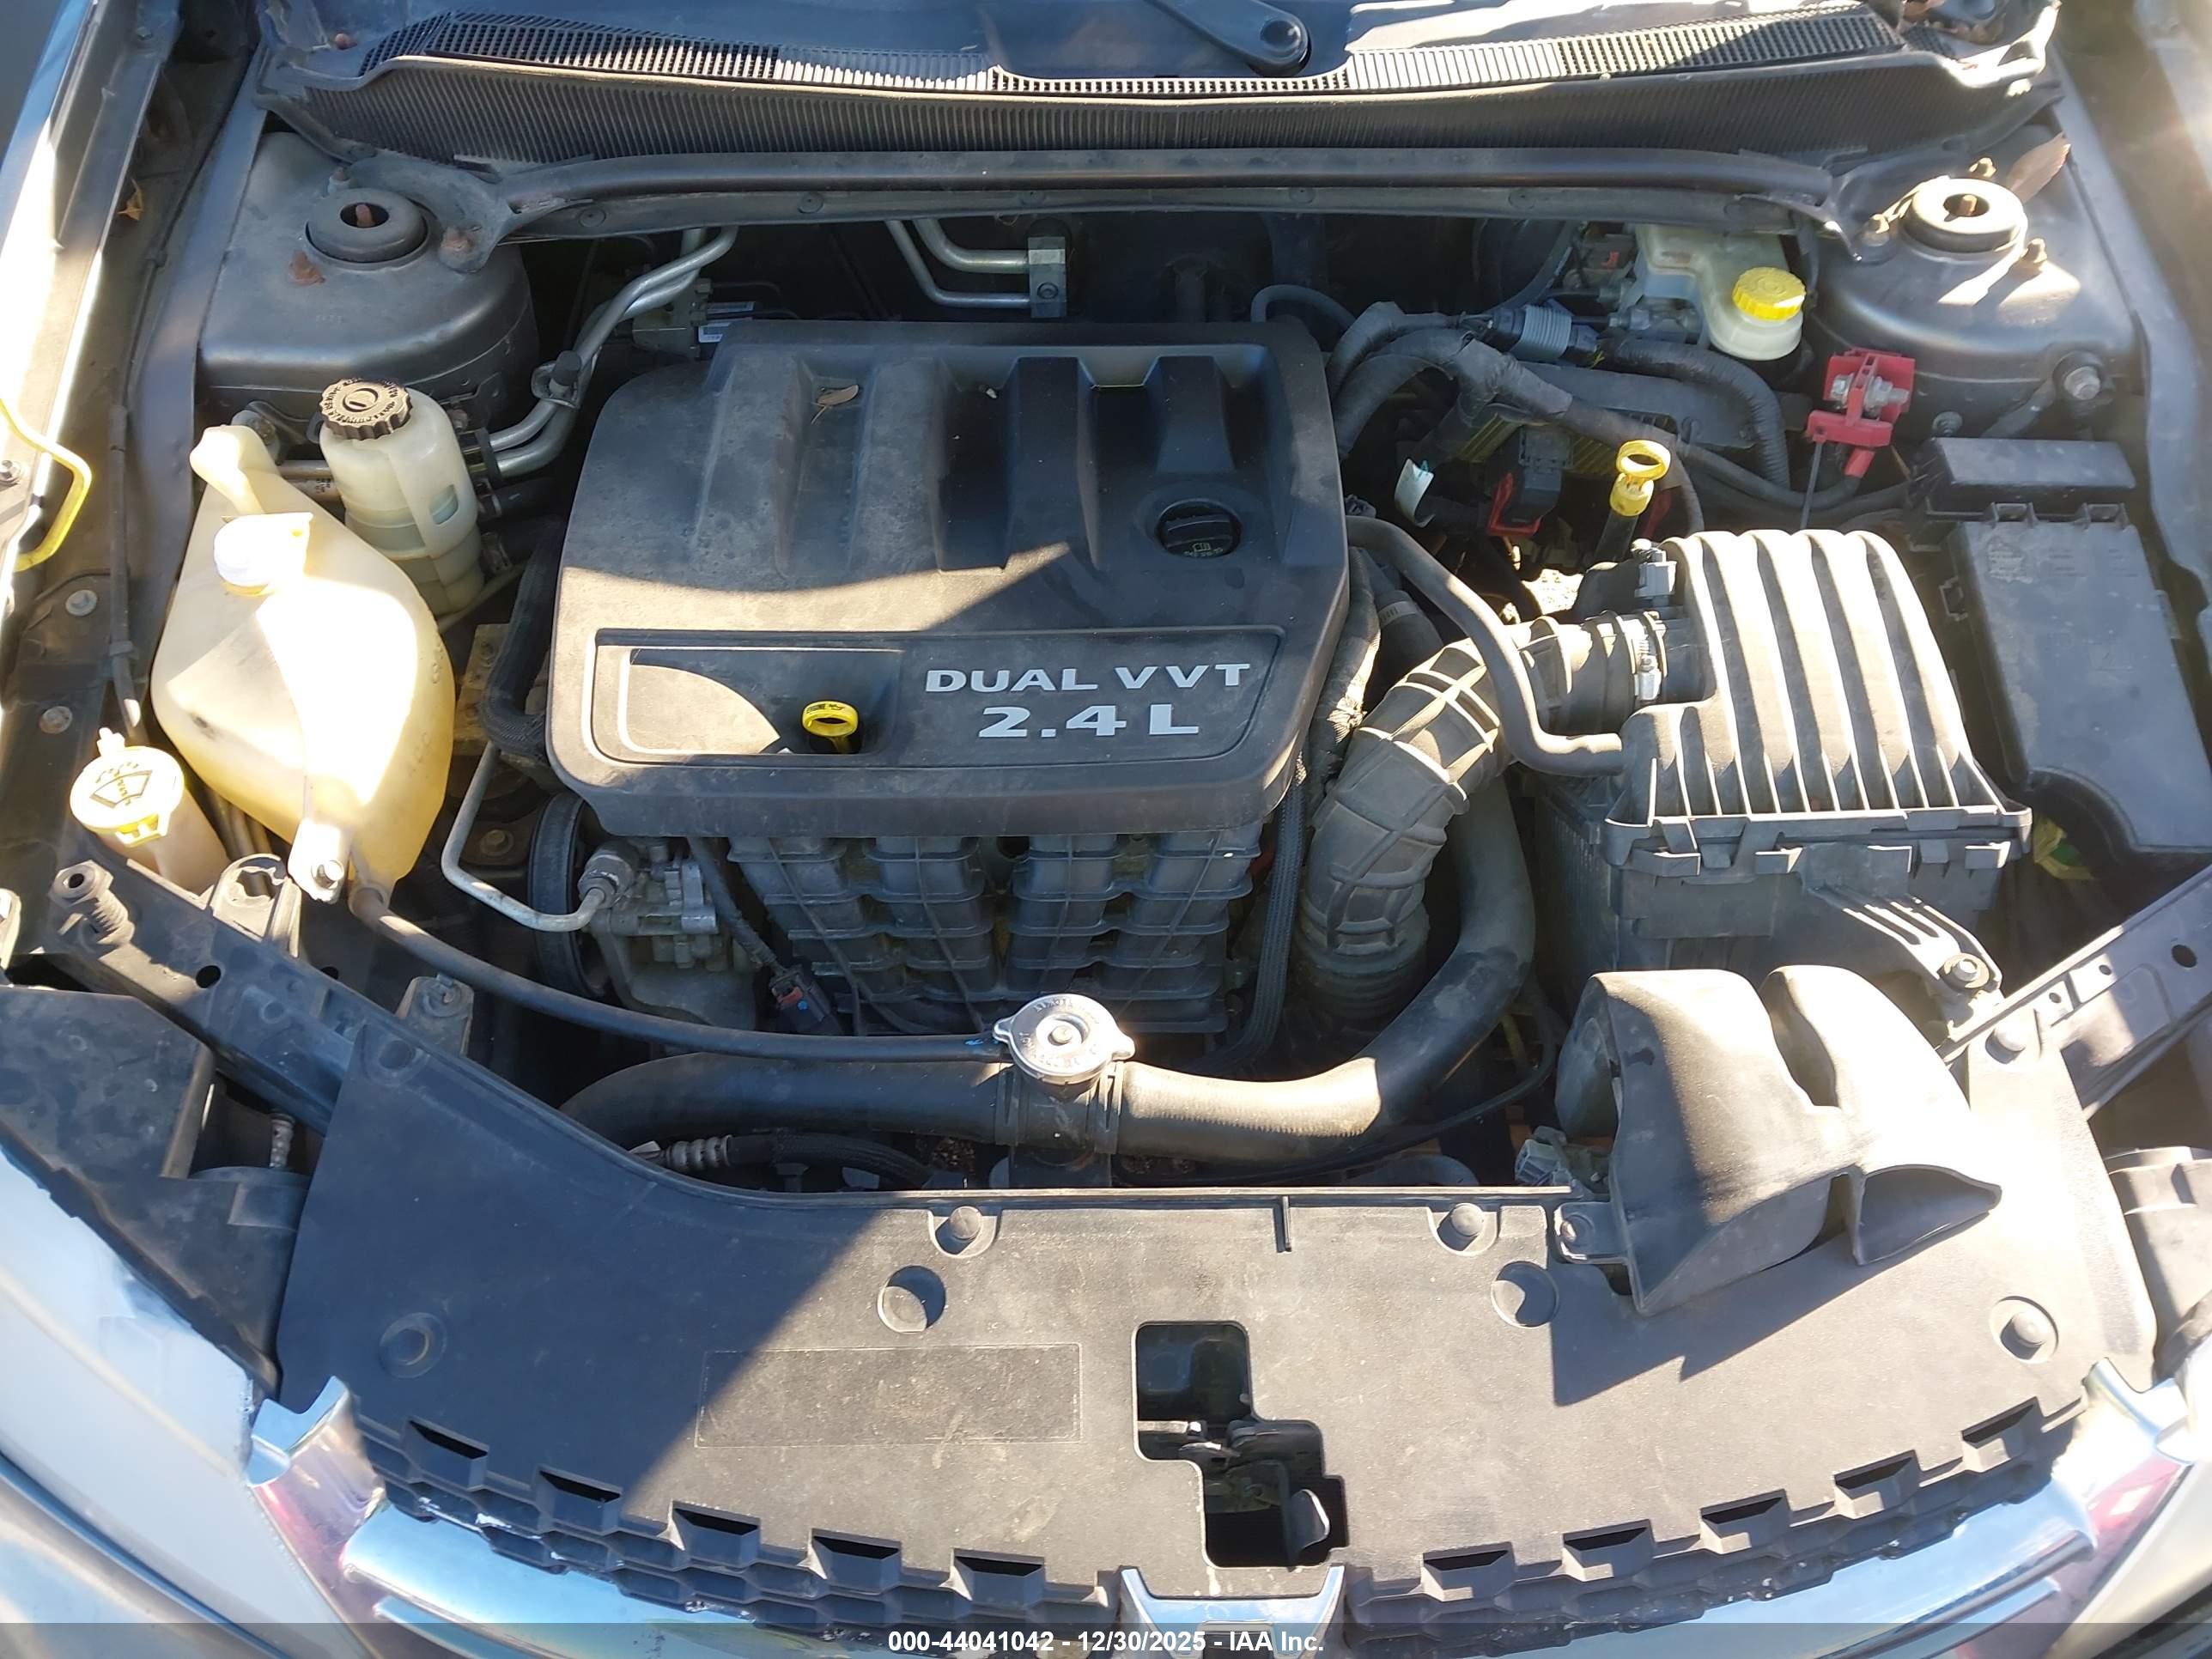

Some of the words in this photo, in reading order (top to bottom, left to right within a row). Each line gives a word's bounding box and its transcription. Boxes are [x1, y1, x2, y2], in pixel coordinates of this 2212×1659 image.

[925, 668, 1099, 693] DUAL
[1115, 663, 1251, 690] VVT
[978, 705, 1127, 738] 2.4
[1148, 703, 1200, 736] L
